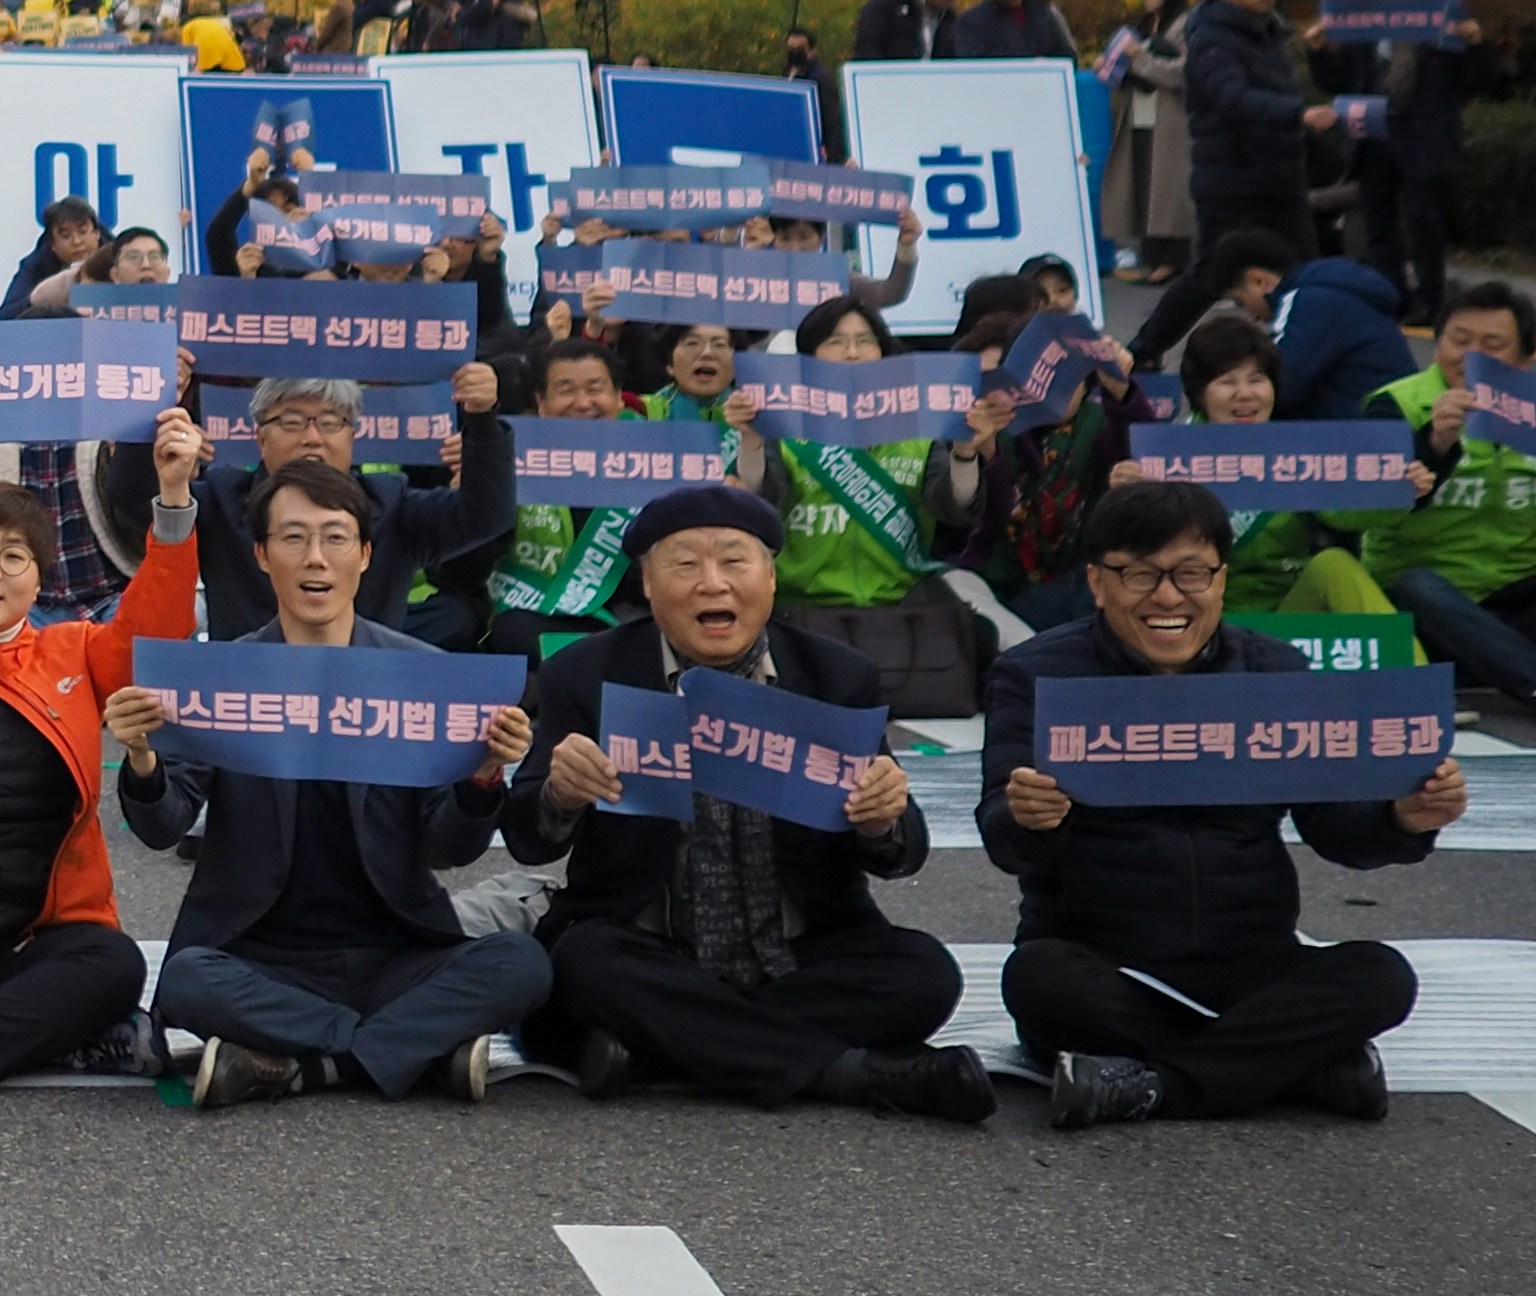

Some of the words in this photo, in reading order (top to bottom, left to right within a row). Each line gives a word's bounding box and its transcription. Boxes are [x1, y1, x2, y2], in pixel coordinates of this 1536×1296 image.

[35, 142, 134, 230] 아
[669, 187, 724, 210] 선거법
[727, 186, 765, 210] 통과
[828, 185, 876, 209] 선거법
[918, 145, 1021, 241] 회
[452, 196, 487, 218] 통과
[334, 216, 389, 243] 선거법
[394, 222, 434, 246] 통과
[610, 267, 718, 300] 패스트트랙
[724, 275, 790, 305] 선거법
[181, 310, 317, 347] 패스트트랙
[325, 315, 407, 350] 선거법
[415, 319, 470, 353] 통과
[96, 364, 165, 402] 통과
[854, 384, 920, 420] 선거법
[356, 414, 399, 440] 거법
[406, 414, 454, 441] 통과
[603, 450, 675, 481] 선거법
[682, 453, 725, 482] 통과
[1140, 454, 1265, 483] 패스트트랙
[1272, 454, 1347, 481] 선거법
[1355, 453, 1408, 481] 통과
[329, 695, 435, 743] 선거법
[691, 713, 796, 774] 선거법
[804, 742, 872, 792] 통과
[1048, 722, 1236, 763] 패스트트랙
[1247, 719, 1358, 760] 선거법
[1371, 714, 1444, 756] 통과
